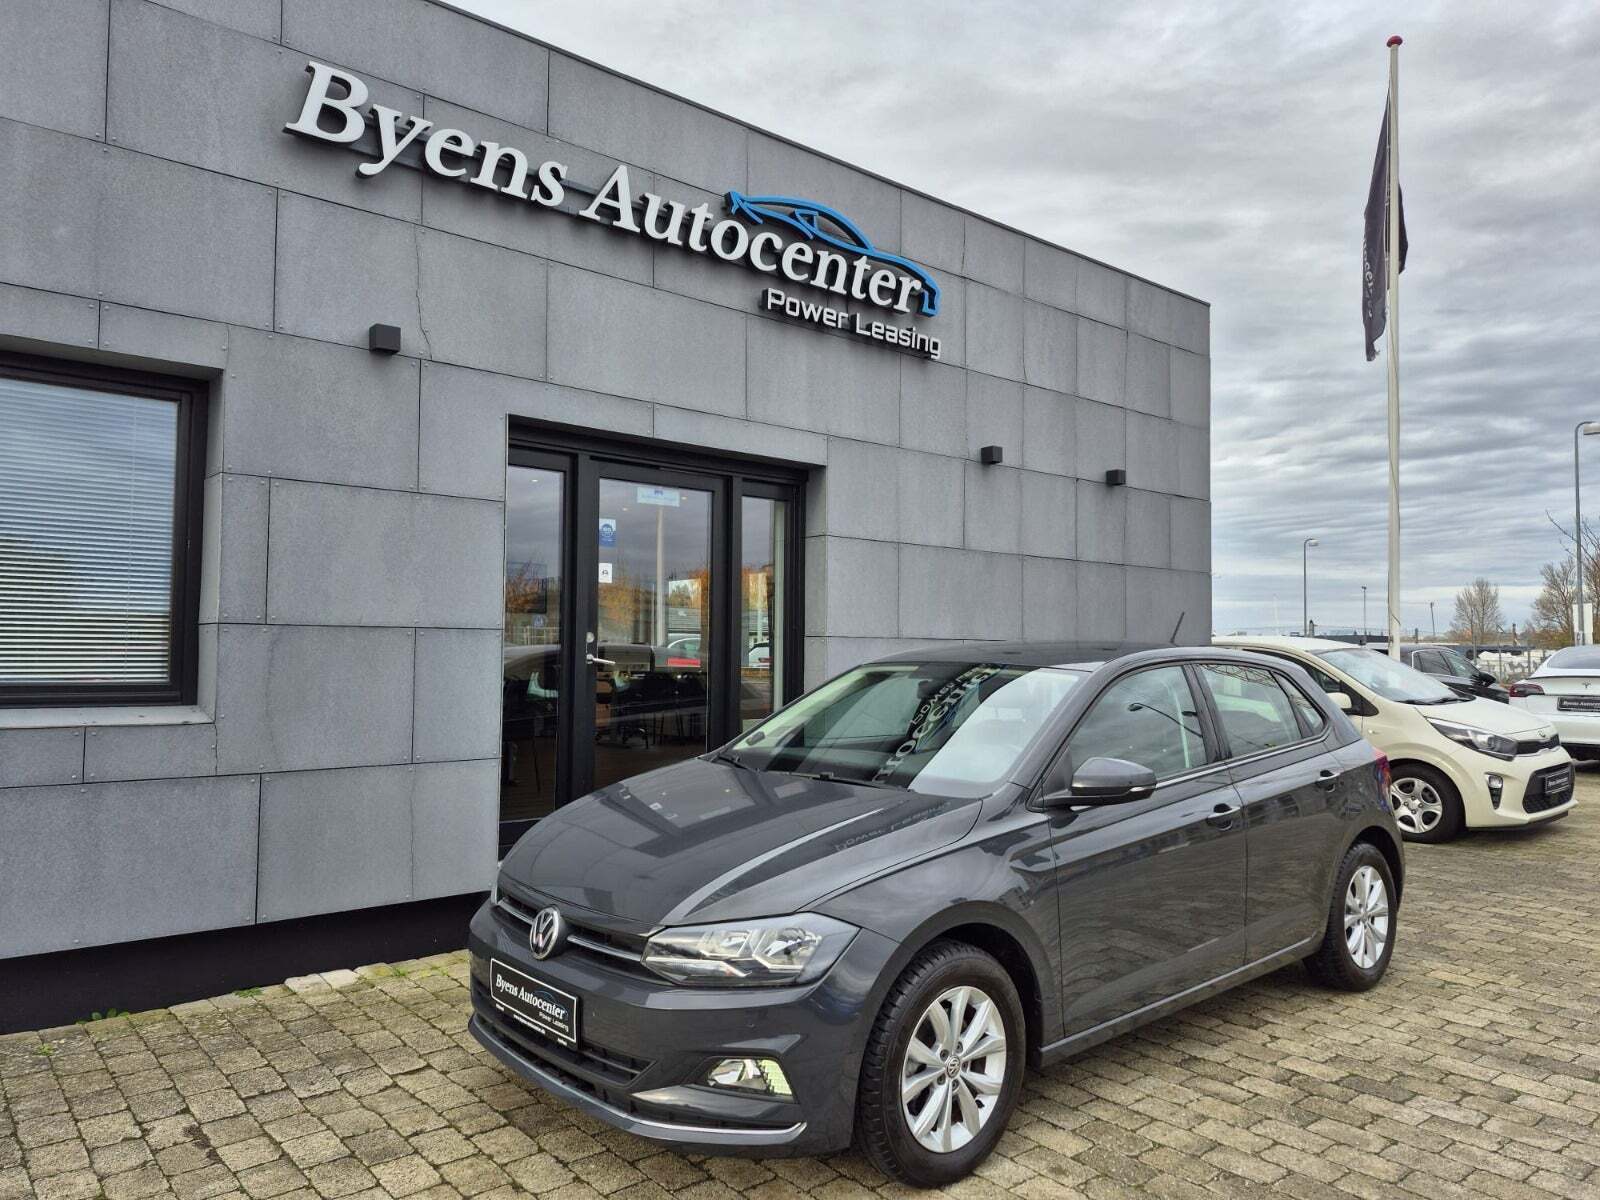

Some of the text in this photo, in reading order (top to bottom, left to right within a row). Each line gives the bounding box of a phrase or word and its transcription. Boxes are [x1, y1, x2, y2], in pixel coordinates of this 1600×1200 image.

[285, 60, 923, 313] Byens Autocenter
[766, 288, 942, 360] Power Leasing
[495, 973, 565, 1019] Byens Autocenter
